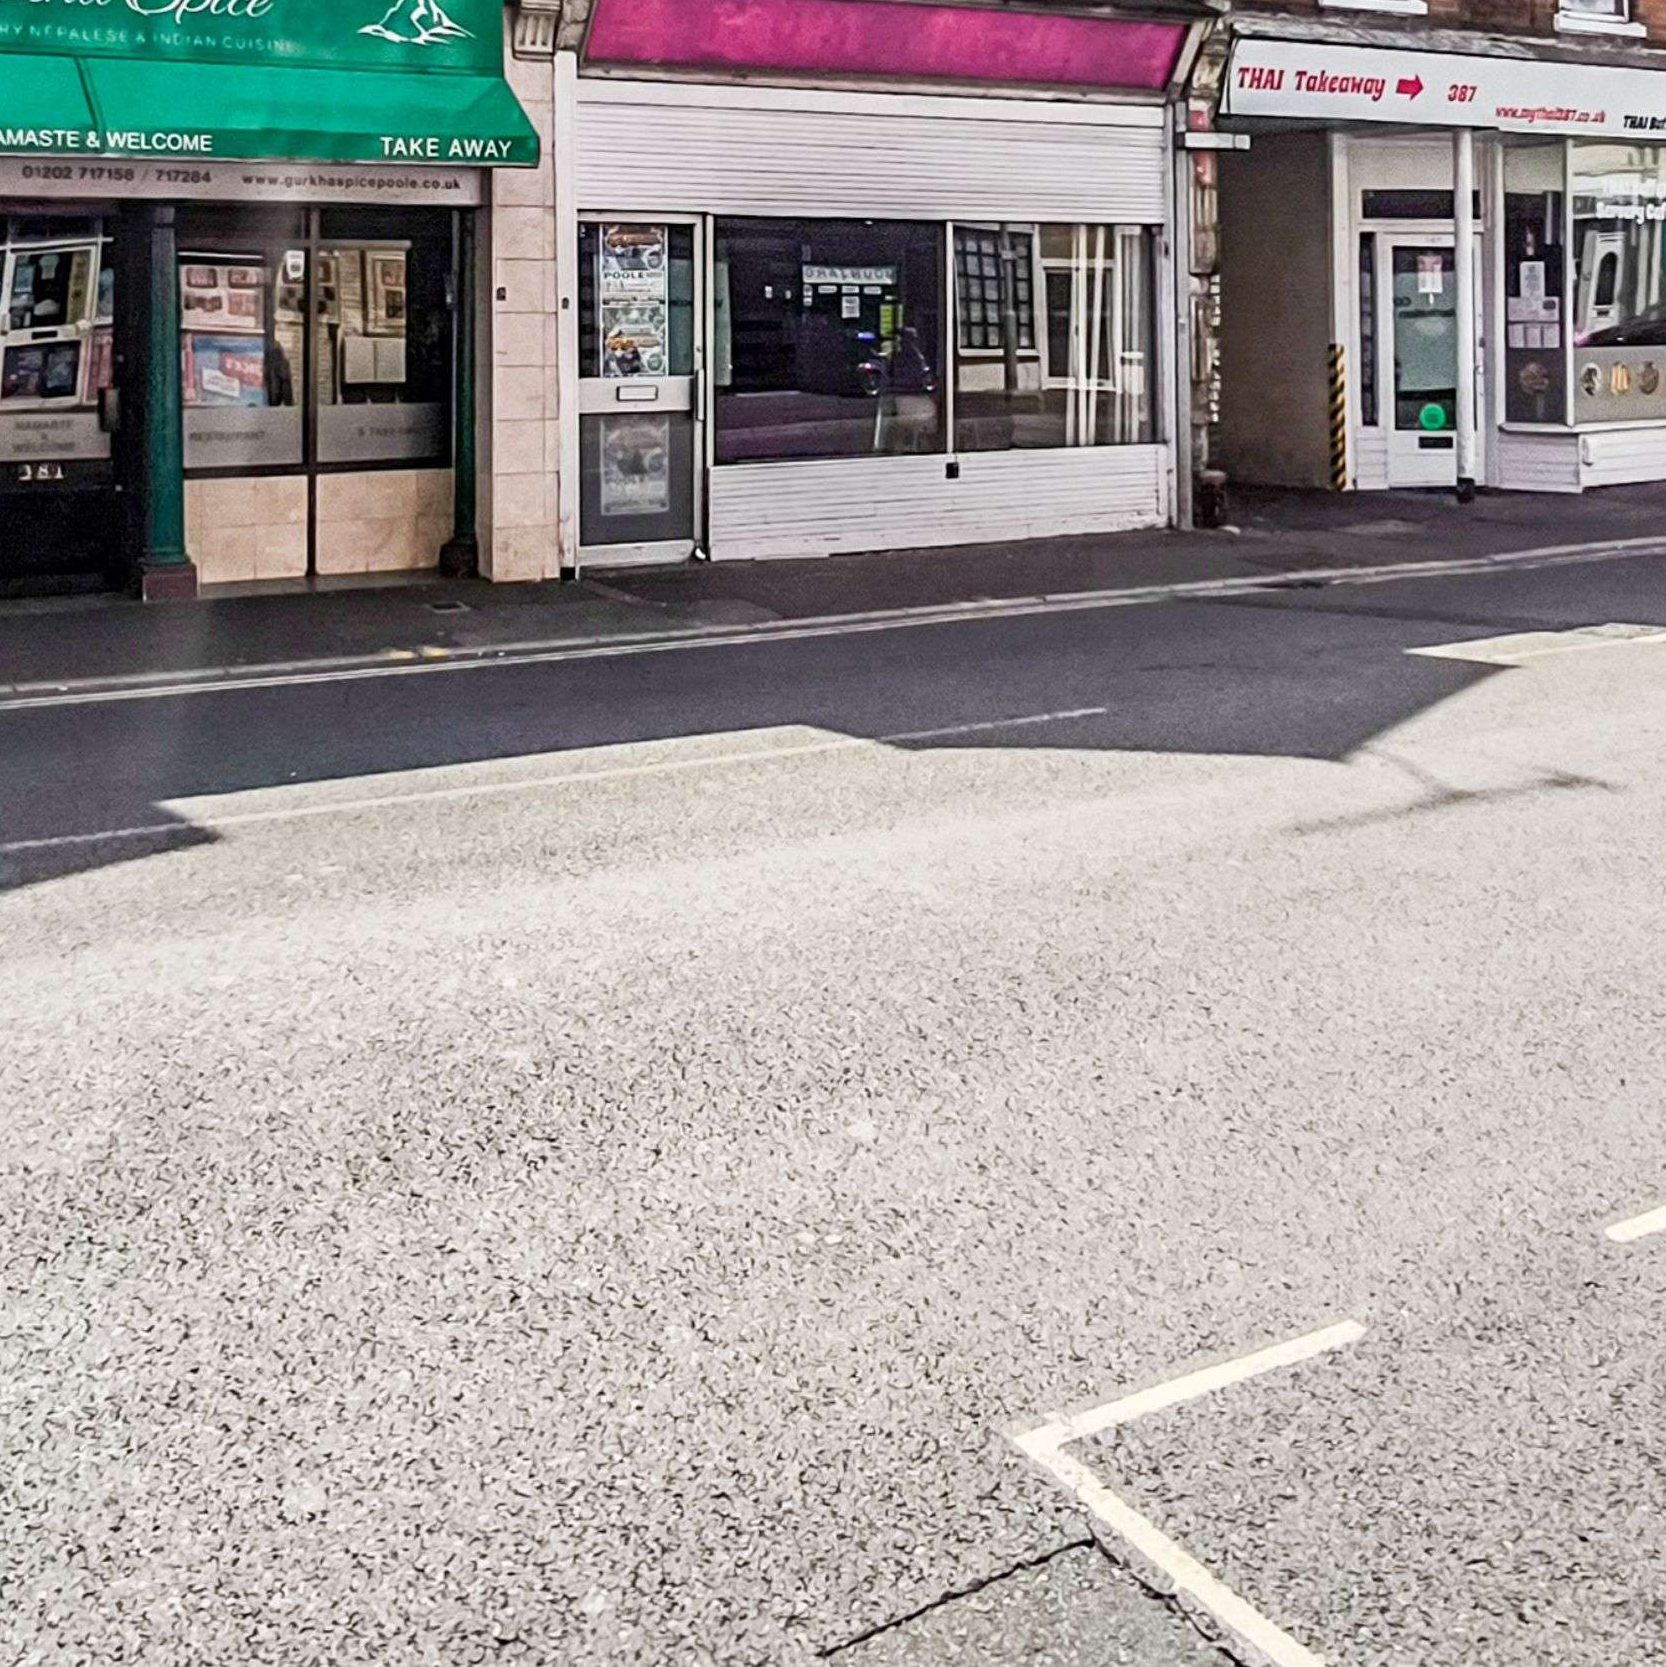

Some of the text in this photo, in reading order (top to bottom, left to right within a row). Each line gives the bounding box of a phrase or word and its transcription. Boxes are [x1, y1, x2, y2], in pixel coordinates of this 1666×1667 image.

[29, 24, 129, 43] NEPALESE
[153, 32, 218, 47] INDIAN
[1237, 67, 1478, 102] THAI Takeaway 387
[86, 131, 101, 149] &
[103, 130, 213, 153] WELCOME
[381, 136, 513, 159] TAKE AWAY
[21, 165, 73, 181] 01202
[78, 167, 134, 182] 717158
[154, 168, 212, 183] 717284
[241, 171, 462, 191] www.gurkhaspicepoole.co.uk
